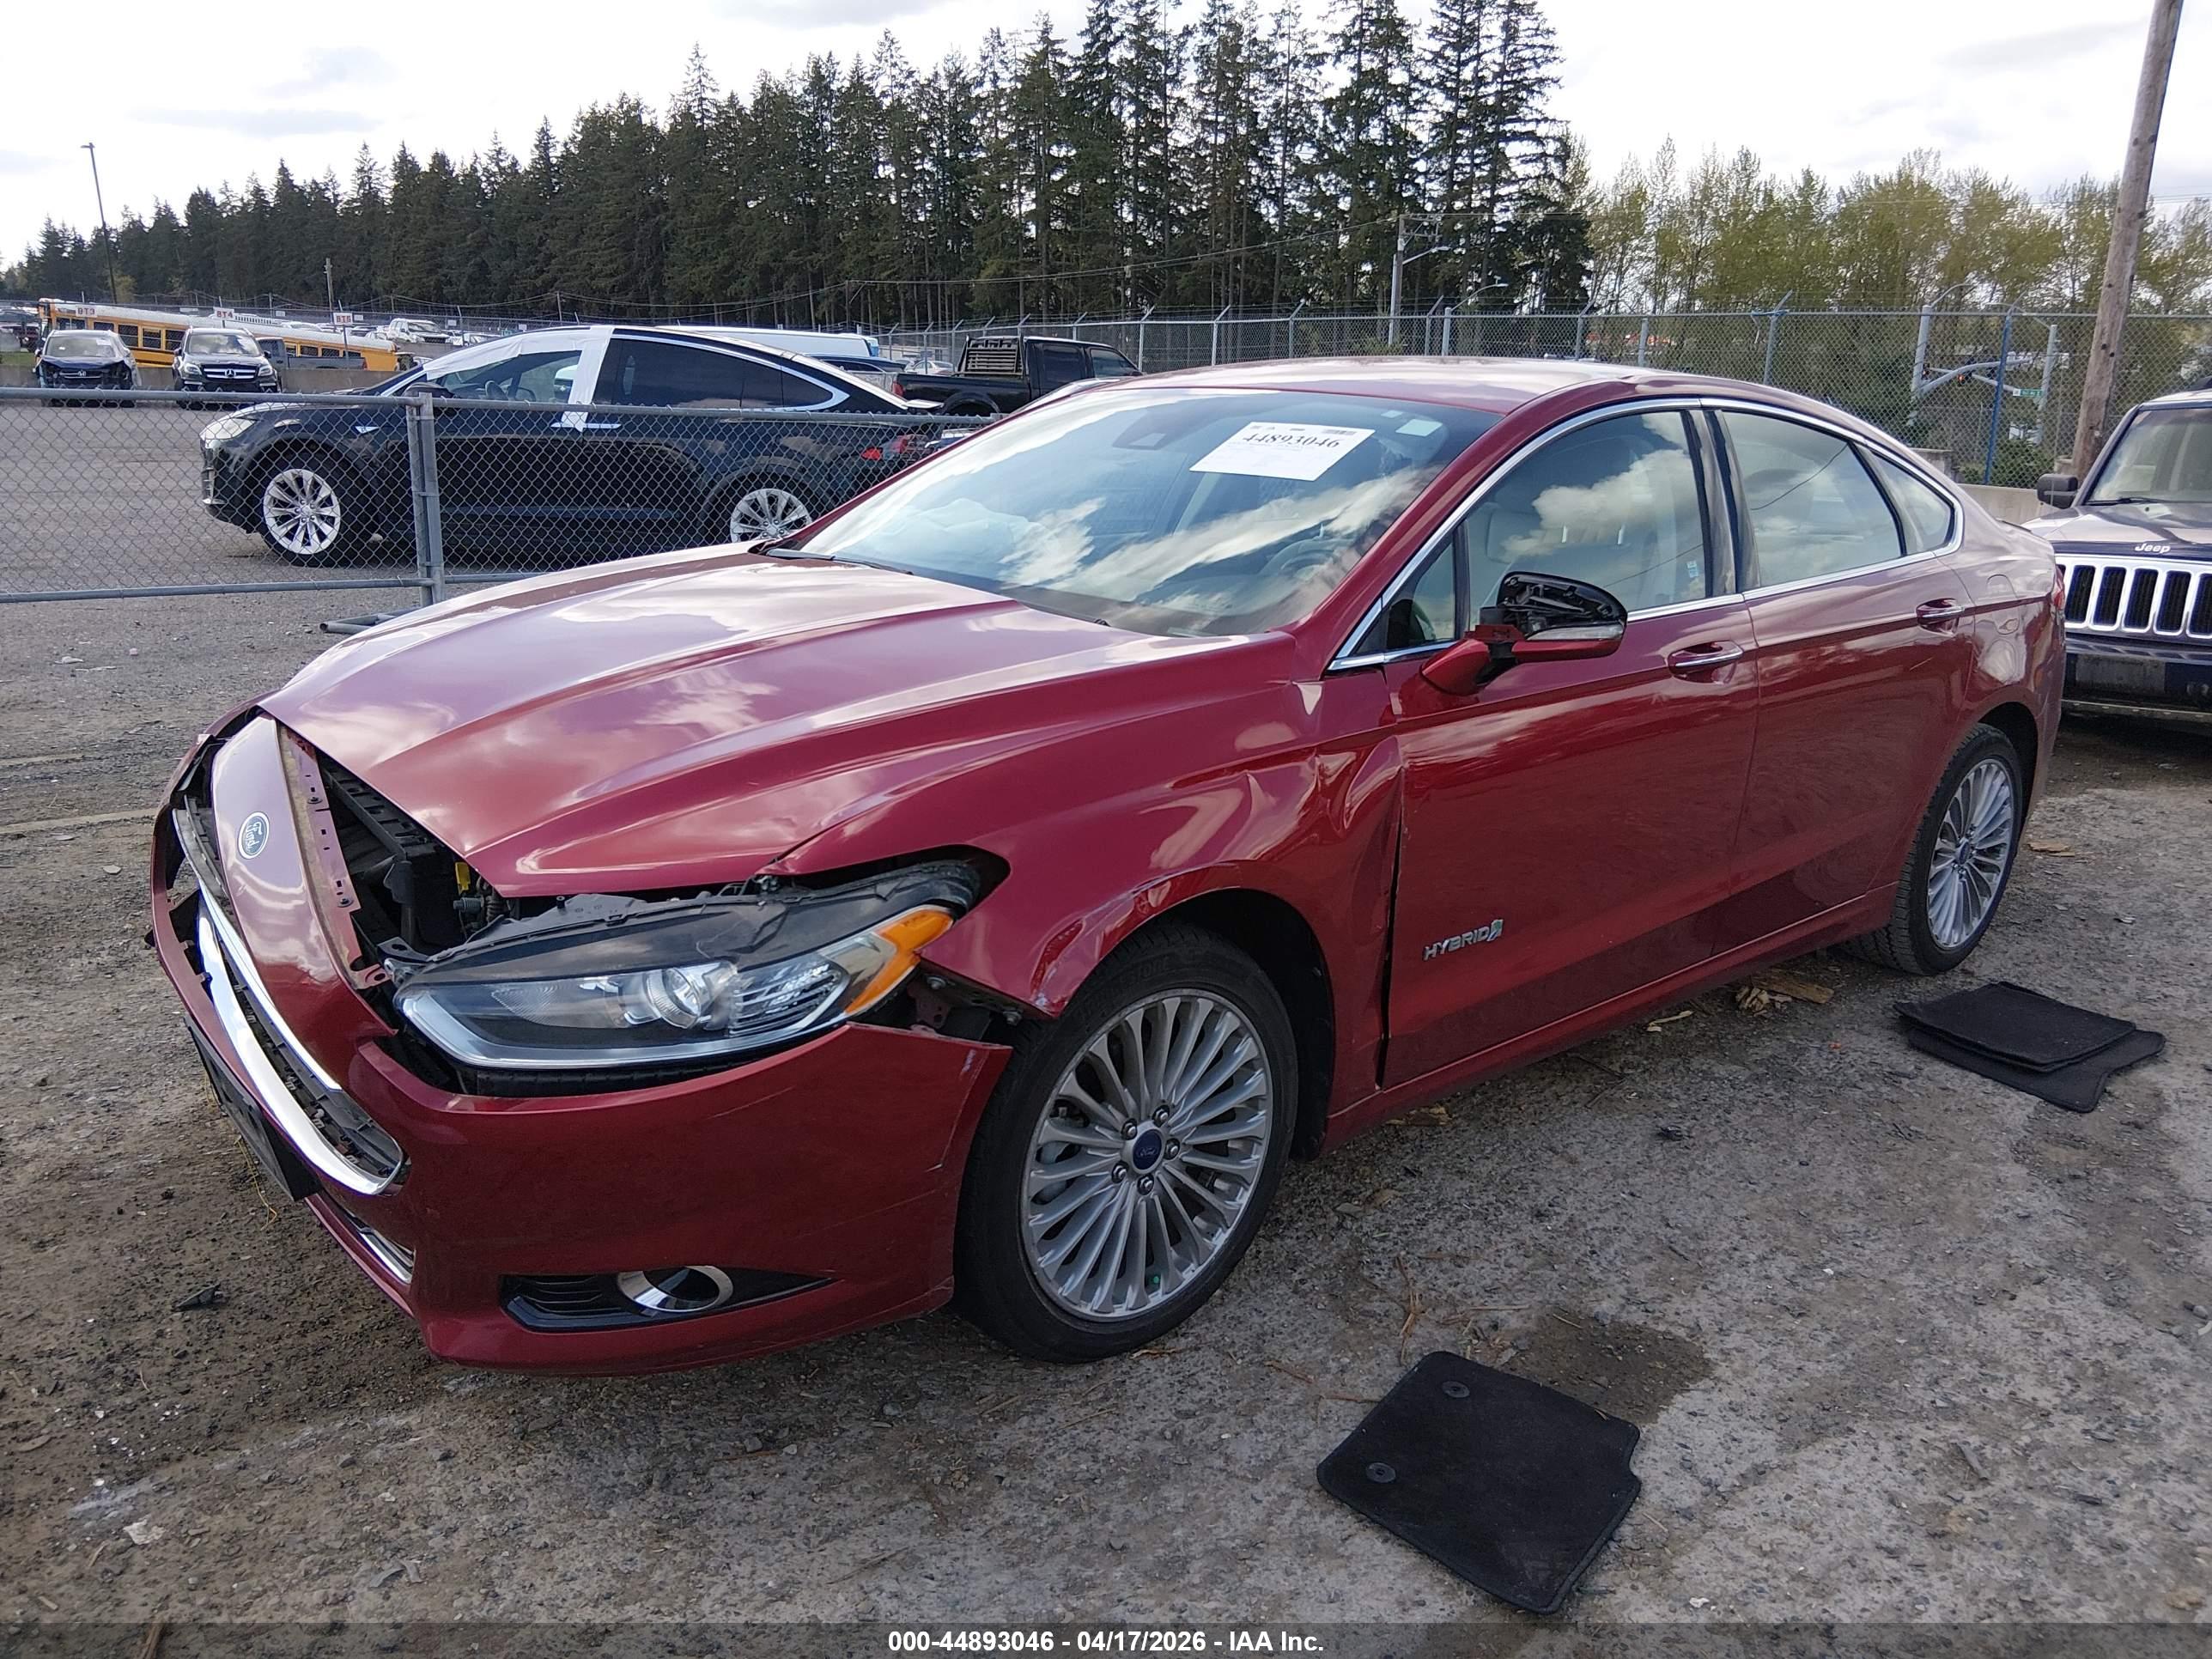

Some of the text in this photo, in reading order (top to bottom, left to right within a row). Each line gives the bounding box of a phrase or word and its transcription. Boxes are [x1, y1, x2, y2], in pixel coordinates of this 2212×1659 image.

[216, 310, 234, 319] BT4
[1243, 432, 1341, 448] 44893046
[2134, 543, 2171, 554] Jeep
[245, 821, 263, 850] Ford
[1423, 926, 1491, 961] HYBRID
